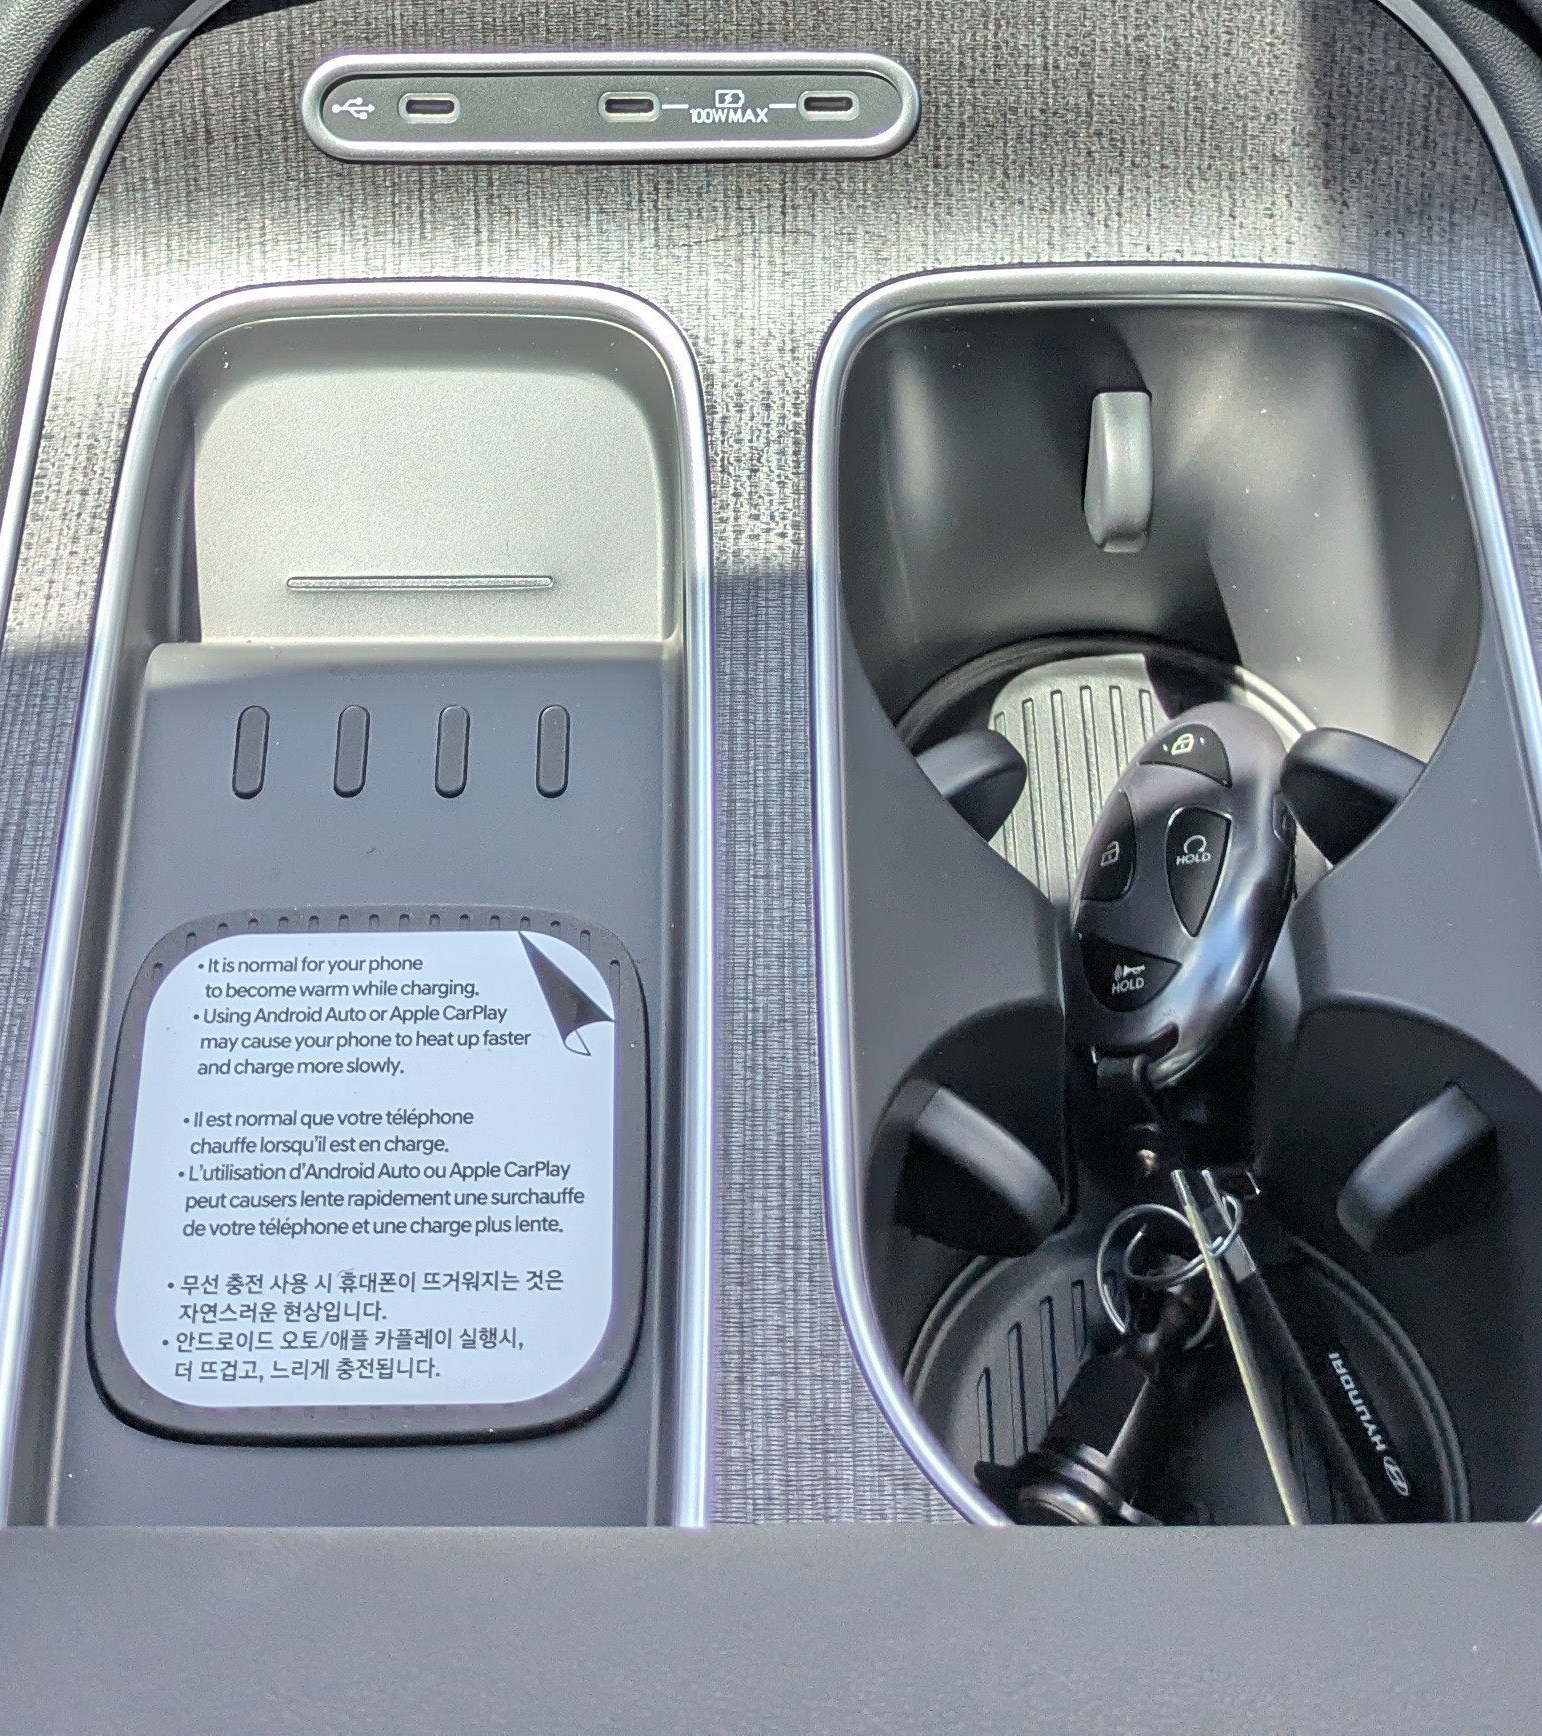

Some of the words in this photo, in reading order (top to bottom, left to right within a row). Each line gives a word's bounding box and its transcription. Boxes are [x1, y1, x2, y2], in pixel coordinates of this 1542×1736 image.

[1176, 852, 1211, 866] HOLD
[207, 957, 221, 974] It
[221, 956, 236, 975] is
[237, 955, 299, 974] normal
[300, 955, 326, 973] for
[326, 958, 367, 974] your
[368, 955, 424, 974] phone
[204, 983, 223, 999] to
[225, 981, 297, 1001] become
[298, 984, 350, 998] warm
[351, 979, 399, 1000] while
[400, 978, 480, 1000] charging.
[1111, 977, 1145, 995] HOLD
[203, 1006, 252, 1028] Using
[252, 1005, 323, 1024] Android
[323, 1006, 367, 1023] Auto
[368, 1008, 389, 1023] or
[388, 1001, 441, 1026] Apple
[442, 1001, 509, 1025] CarPlay
[199, 1032, 240, 1054] may
[240, 1031, 294, 1050] cause
[292, 1035, 335, 1053] your
[335, 1030, 393, 1052] phone
[393, 1030, 415, 1048] to
[415, 1029, 456, 1048] heat
[456, 1033, 481, 1050] up
[481, 1029, 533, 1050] faster
[196, 1057, 232, 1076] and
[232, 1057, 295, 1079] charge
[296, 1056, 345, 1075] more
[345, 1056, 405, 1077] slowly.
[193, 1110, 204, 1128] Il
[205, 1111, 235, 1129] est
[234, 1108, 298, 1128] normal
[299, 1112, 335, 1130] que
[336, 1110, 384, 1129] votre
[383, 1107, 475, 1130] téléphone
[189, 1135, 258, 1156] chauffe
[259, 1131, 327, 1158] lorsqu'il
[328, 1136, 357, 1153] est
[357, 1139, 382, 1153] en
[383, 1131, 450, 1157] charge.
[188, 1160, 287, 1185] L'utilisation
[288, 1159, 376, 1185] d'Android
[376, 1161, 423, 1184] Auto
[422, 1162, 447, 1183] ou
[448, 1160, 502, 1183] Apple
[503, 1159, 572, 1182] CarPlay
[184, 1192, 228, 1214] peut
[227, 1193, 298, 1213] causers
[299, 1188, 346, 1209] lente
[345, 1188, 452, 1211] rapidement
[451, 1191, 490, 1209] une
[488, 1185, 587, 1208] surchauffe
[181, 1218, 207, 1238] de
[208, 1219, 257, 1240] votre
[257, 1216, 350, 1240] téléphone
[351, 1217, 371, 1235] et
[372, 1219, 409, 1235] une
[409, 1215, 474, 1239] charge
[474, 1214, 514, 1238] plus
[514, 1214, 564, 1234] lente.
[179, 1273, 220, 1296] 무선
[224, 1272, 266, 1296] 충전
[268, 1272, 309, 1296] 사용
[313, 1272, 333, 1295] 시
[336, 1268, 416, 1294] 휴대폰이
[421, 1269, 521, 1293] 뜨거워지는
[523, 1269, 567, 1292] 것은
[178, 1301, 279, 1325] 자연스러운
[282, 1299, 387, 1324] 현상입니다.
[175, 1326, 275, 1354] 안드로이드
[278, 1327, 371, 1352] 오토/애플
[373, 1327, 453, 1351] 카플레이
[458, 1326, 524, 1351] 실행시,
[174, 1360, 193, 1383] 더
[197, 1358, 265, 1384] 뜨겁고,
[269, 1358, 330, 1381] 느리게
[335, 1355, 441, 1382] 충전됩니다.
[1329, 1352, 1387, 1452] HYUNDAI
